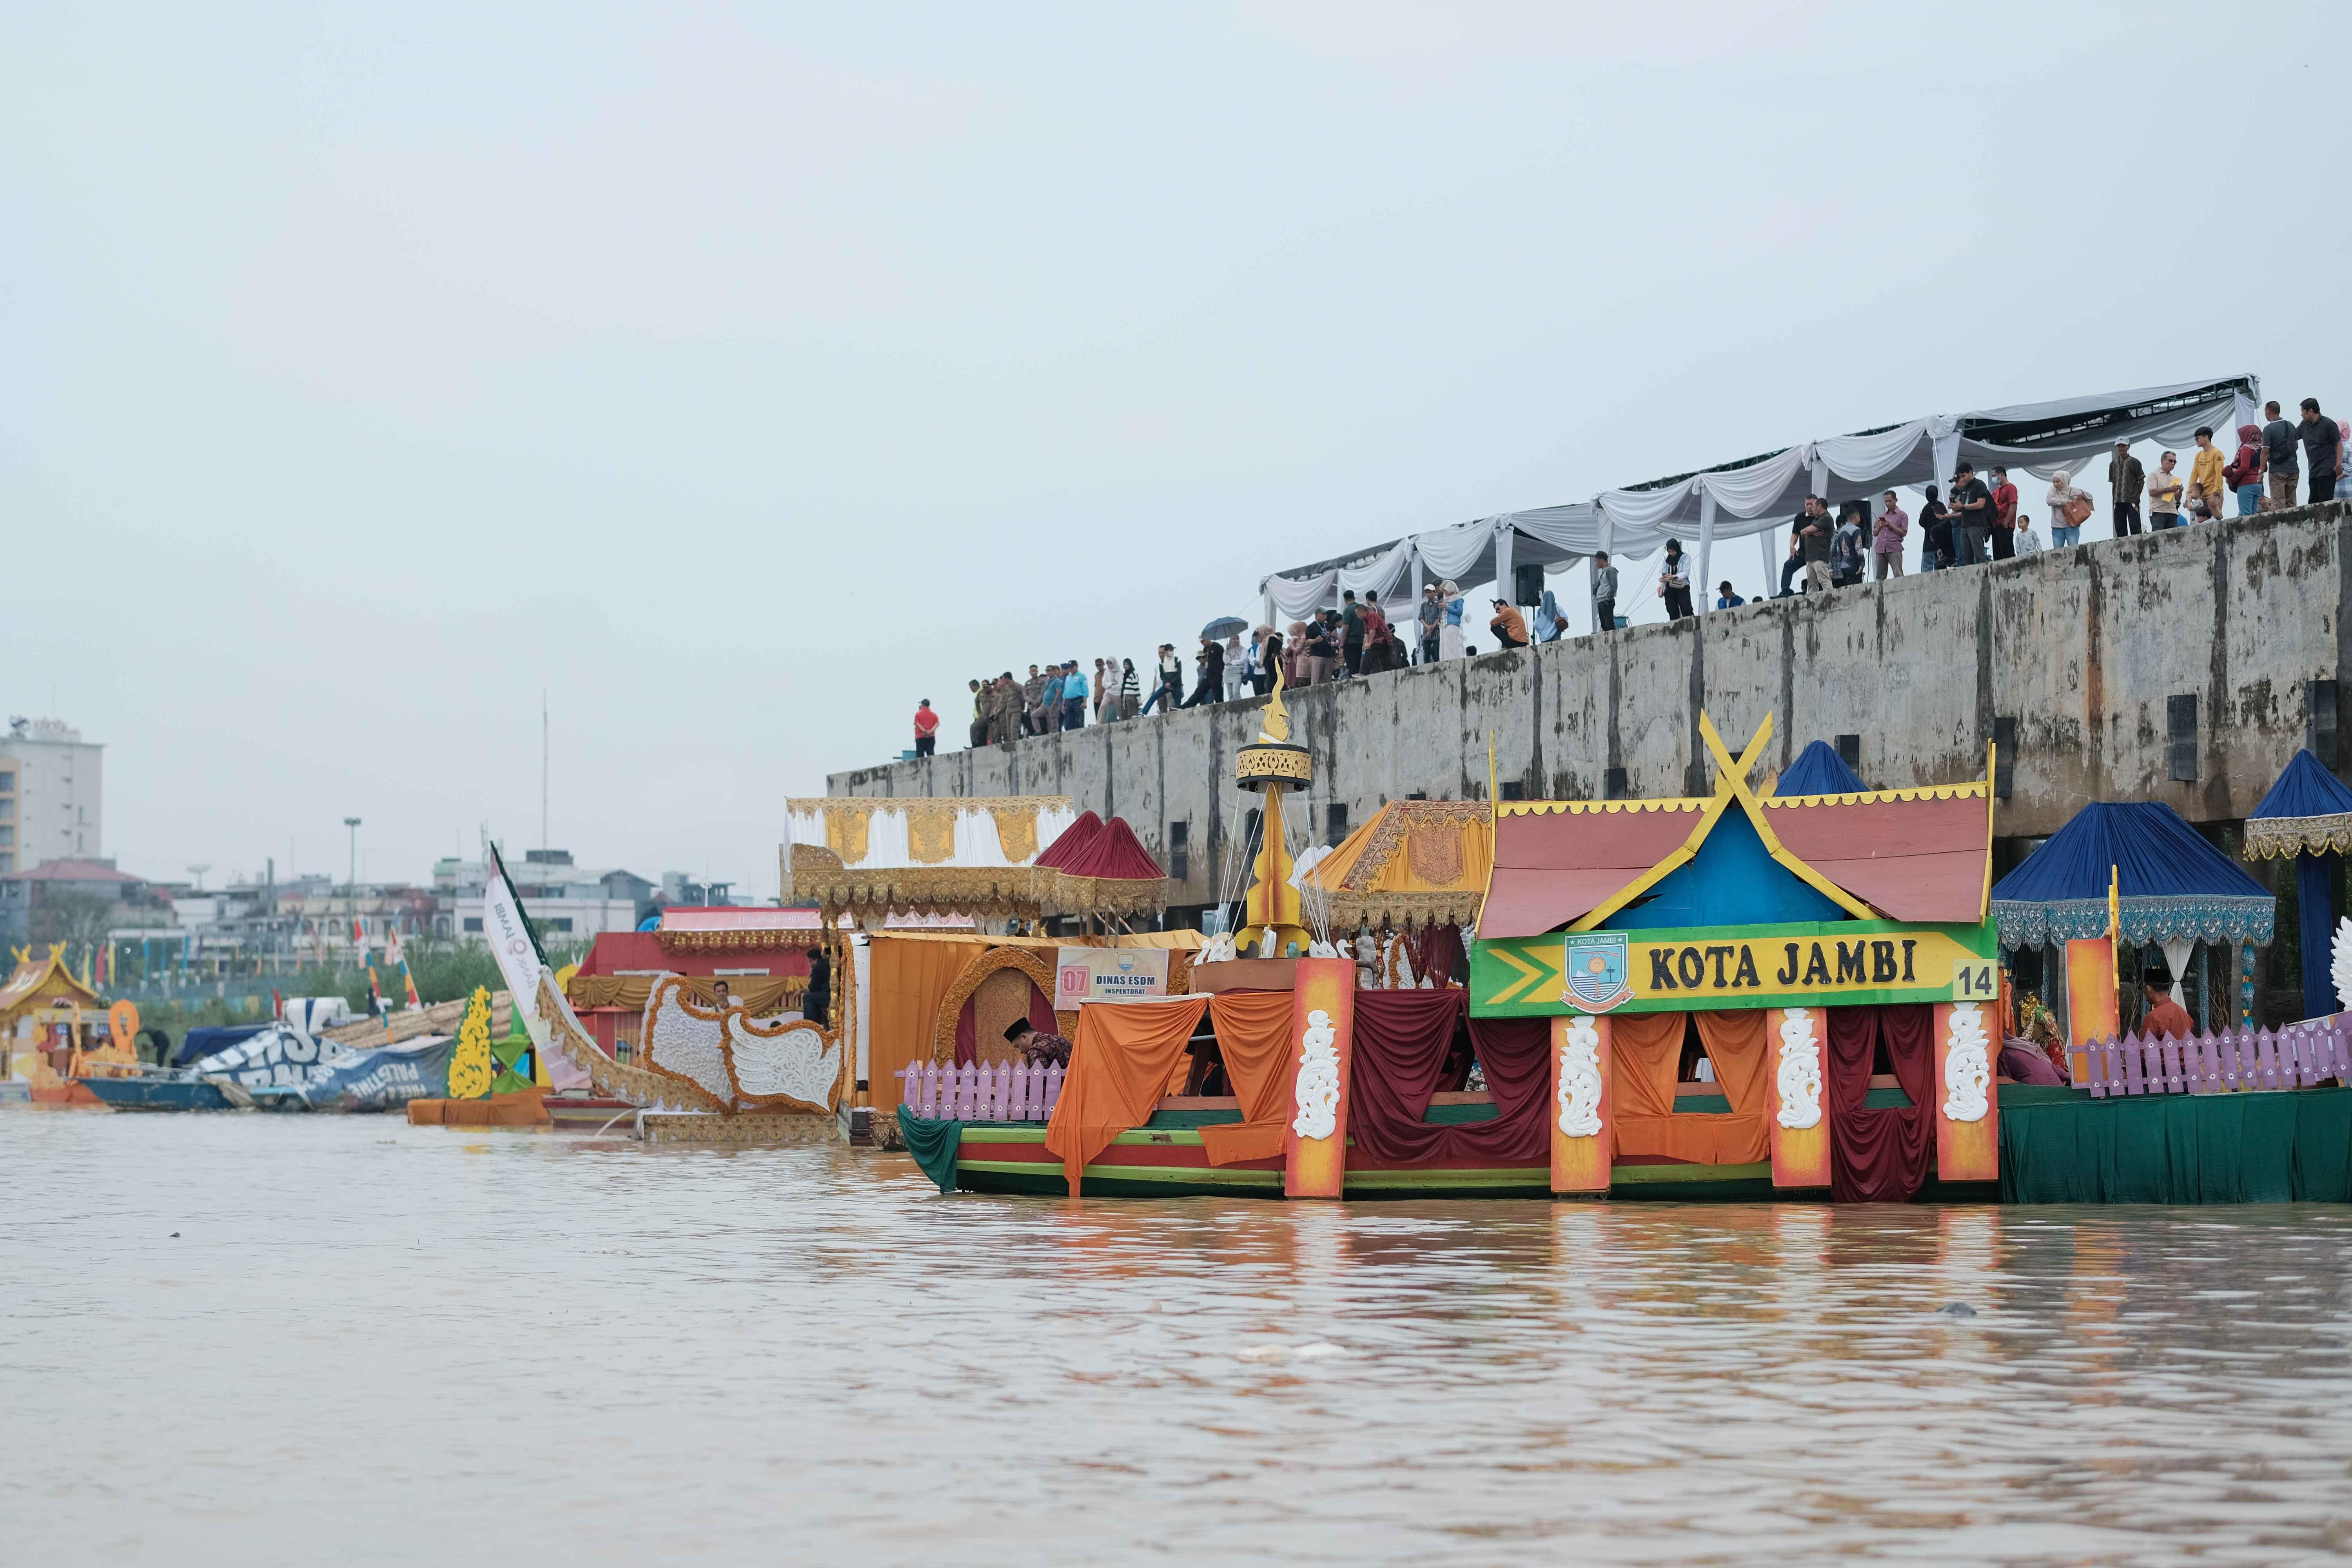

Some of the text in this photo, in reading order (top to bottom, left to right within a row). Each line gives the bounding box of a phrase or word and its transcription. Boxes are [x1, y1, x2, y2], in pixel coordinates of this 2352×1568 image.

[1649, 940, 1917, 990] KOTA JAMBI
[1063, 969, 1087, 993] 07
[1096, 976, 1155, 985] DINAS ESDM
[1959, 966, 1992, 995] 14
